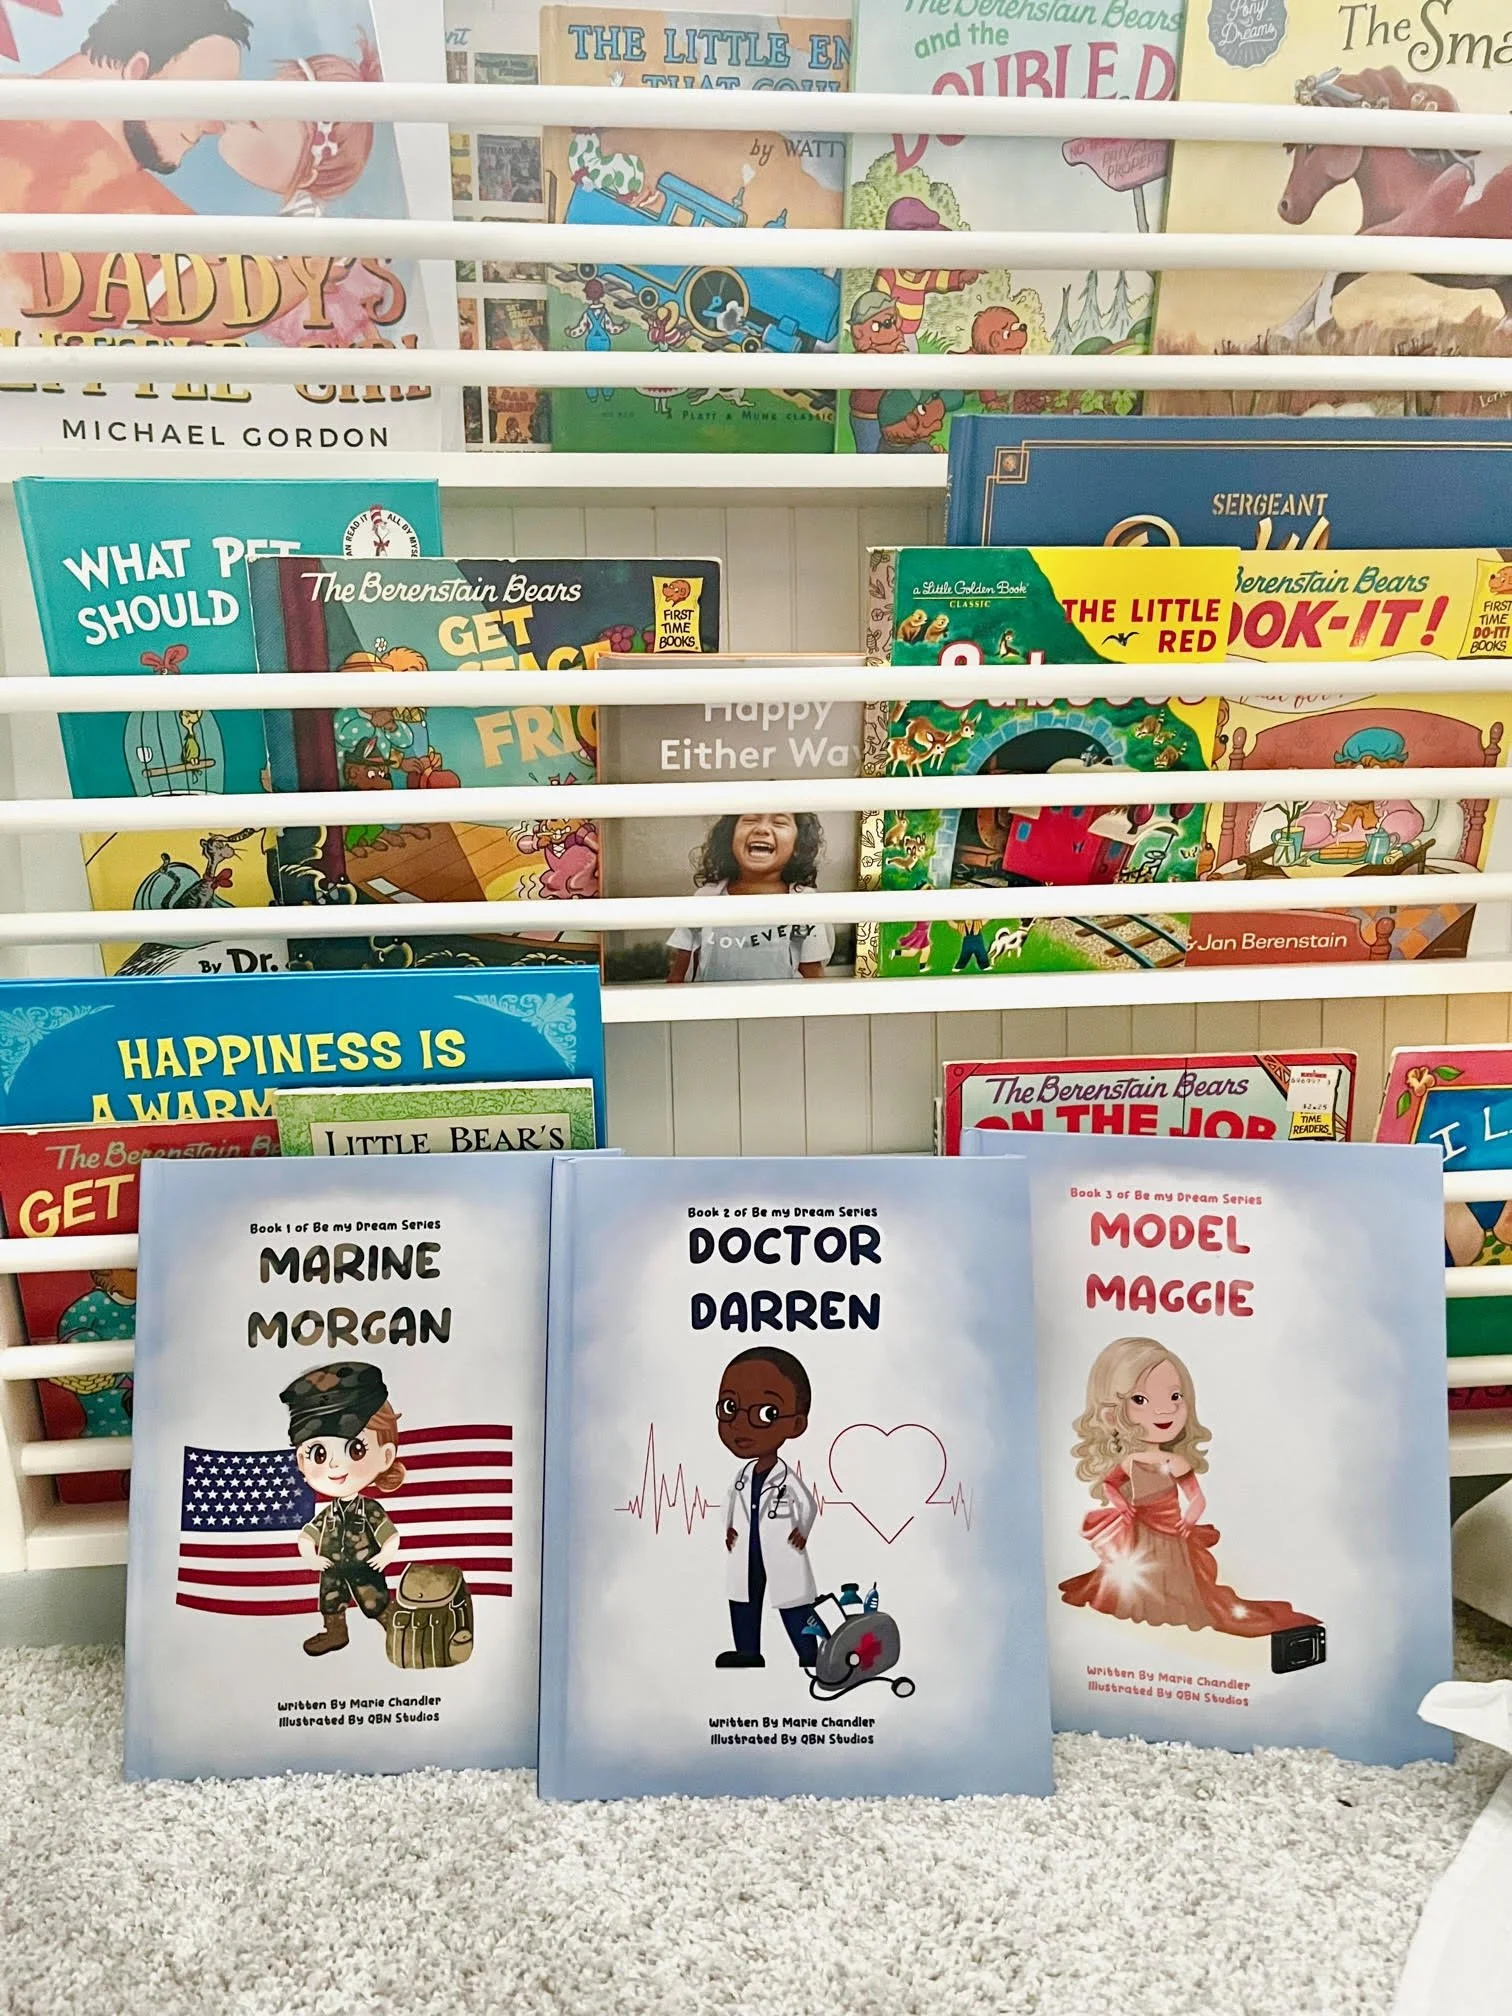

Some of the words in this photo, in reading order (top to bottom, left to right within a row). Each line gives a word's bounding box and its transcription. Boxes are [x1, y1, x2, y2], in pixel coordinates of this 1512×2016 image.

[914, 23, 960, 59] and
[968, 21, 1009, 46] the
[1218, 21, 1277, 47] Dreams
[1339, 3, 1410, 51] The
[568, 25, 646, 61] THE
[664, 28, 790, 68] LITTLE
[750, 139, 774, 165] by
[63, 419, 225, 447] MICHAEL
[242, 426, 388, 448] GORDON
[1211, 493, 1328, 516] SERGEANT
[345, 521, 360, 542] READ
[360, 514, 368, 523] IT
[387, 514, 401, 526] ALL
[62, 538, 192, 592] WHAT
[300, 572, 355, 602] The
[358, 571, 499, 602] Berenstain
[502, 575, 582, 603] Bears
[922, 581, 953, 594] Little
[954, 580, 995, 594] Golden
[997, 580, 1027, 594] Book
[1352, 566, 1429, 594] Bears
[664, 609, 694, 621] FIRST
[949, 600, 991, 608] CLASSIC
[1062, 599, 1116, 623] THE
[1132, 599, 1221, 623] LITTLE
[77, 589, 240, 647] SHOULD
[438, 605, 533, 656] GET
[661, 622, 691, 634] TIME
[1479, 614, 1509, 625] TIME
[659, 635, 695, 649] BOOKS
[1158, 630, 1216, 653] RED
[1473, 626, 1510, 639] DO-IT!
[1470, 640, 1507, 654] BOOKS
[661, 739, 776, 770] Either
[1198, 934, 1236, 951] Jan
[1242, 932, 1347, 950] Berenstain
[198, 960, 222, 974] By
[226, 949, 278, 973] Dr.
[117, 1032, 402, 1080] HAPPINESS
[419, 1029, 466, 1070] IS
[986, 1078, 1034, 1105] The
[1037, 1074, 1168, 1103] Berenstain
[1173, 1068, 1249, 1098] Bears
[92, 1094, 116, 1122] A
[1301, 1115, 1322, 1123] TIME
[1056, 1104, 1159, 1135] THE
[1170, 1108, 1276, 1140] JOB
[1293, 1125, 1329, 1134] READERS
[325, 1131, 431, 1157] LITTLE
[449, 1125, 565, 1152] BEAR'S
[46, 1143, 100, 1170] The
[19, 1174, 134, 1238] GET
[1070, 1187, 1101, 1198] Book
[1106, 1190, 1112, 1199] 3
[1117, 1190, 1130, 1200] of
[1134, 1190, 1150, 1201] Be
[1154, 1193, 1173, 1203] my
[1177, 1192, 1218, 1203] Dream
[1223, 1194, 1263, 1205] Series
[688, 1207, 719, 1218] Book
[723, 1208, 730, 1218] 2
[734, 1207, 748, 1217] of
[752, 1207, 768, 1217] Be
[771, 1208, 790, 1219] my
[794, 1207, 834, 1217] Dream
[839, 1207, 878, 1217] Series
[250, 1223, 282, 1234] Book
[286, 1224, 291, 1233] 1
[295, 1222, 309, 1233] of
[313, 1222, 329, 1232] Be
[333, 1222, 351, 1233] my
[356, 1220, 397, 1232] Dream
[401, 1219, 441, 1230] Series
[1091, 1211, 1250, 1254] MODEL
[689, 1225, 882, 1266] DOCTOR
[260, 1241, 441, 1284] MARINE
[1086, 1273, 1255, 1317] MAGGIE
[691, 1290, 881, 1333] DARREN
[248, 1306, 452, 1348] MORGAN
[1087, 1665, 1135, 1679] Written
[1139, 1670, 1154, 1682] By
[1158, 1672, 1192, 1685] Marie
[1197, 1677, 1251, 1690] Chandler
[277, 1699, 327, 1711] Written
[330, 1699, 346, 1710] By
[350, 1698, 384, 1709] Marie
[388, 1695, 441, 1707] Chandler
[1088, 1680, 1153, 1697] Illustrated
[1156, 1688, 1173, 1700] By
[1176, 1690, 1200, 1702] QBN
[1204, 1693, 1249, 1706] Studios
[279, 1714, 345, 1727] Illustrated
[348, 1713, 364, 1725] By
[368, 1713, 392, 1724] QBN
[395, 1711, 439, 1723] Studios
[709, 1717, 758, 1728] Written
[762, 1716, 779, 1728] By
[782, 1717, 818, 1728] Marie
[821, 1716, 876, 1728] Chandler
[711, 1733, 777, 1745] Illustrated
[781, 1733, 797, 1745] By
[801, 1733, 825, 1745] QBN
[829, 1733, 874, 1744] Studios
